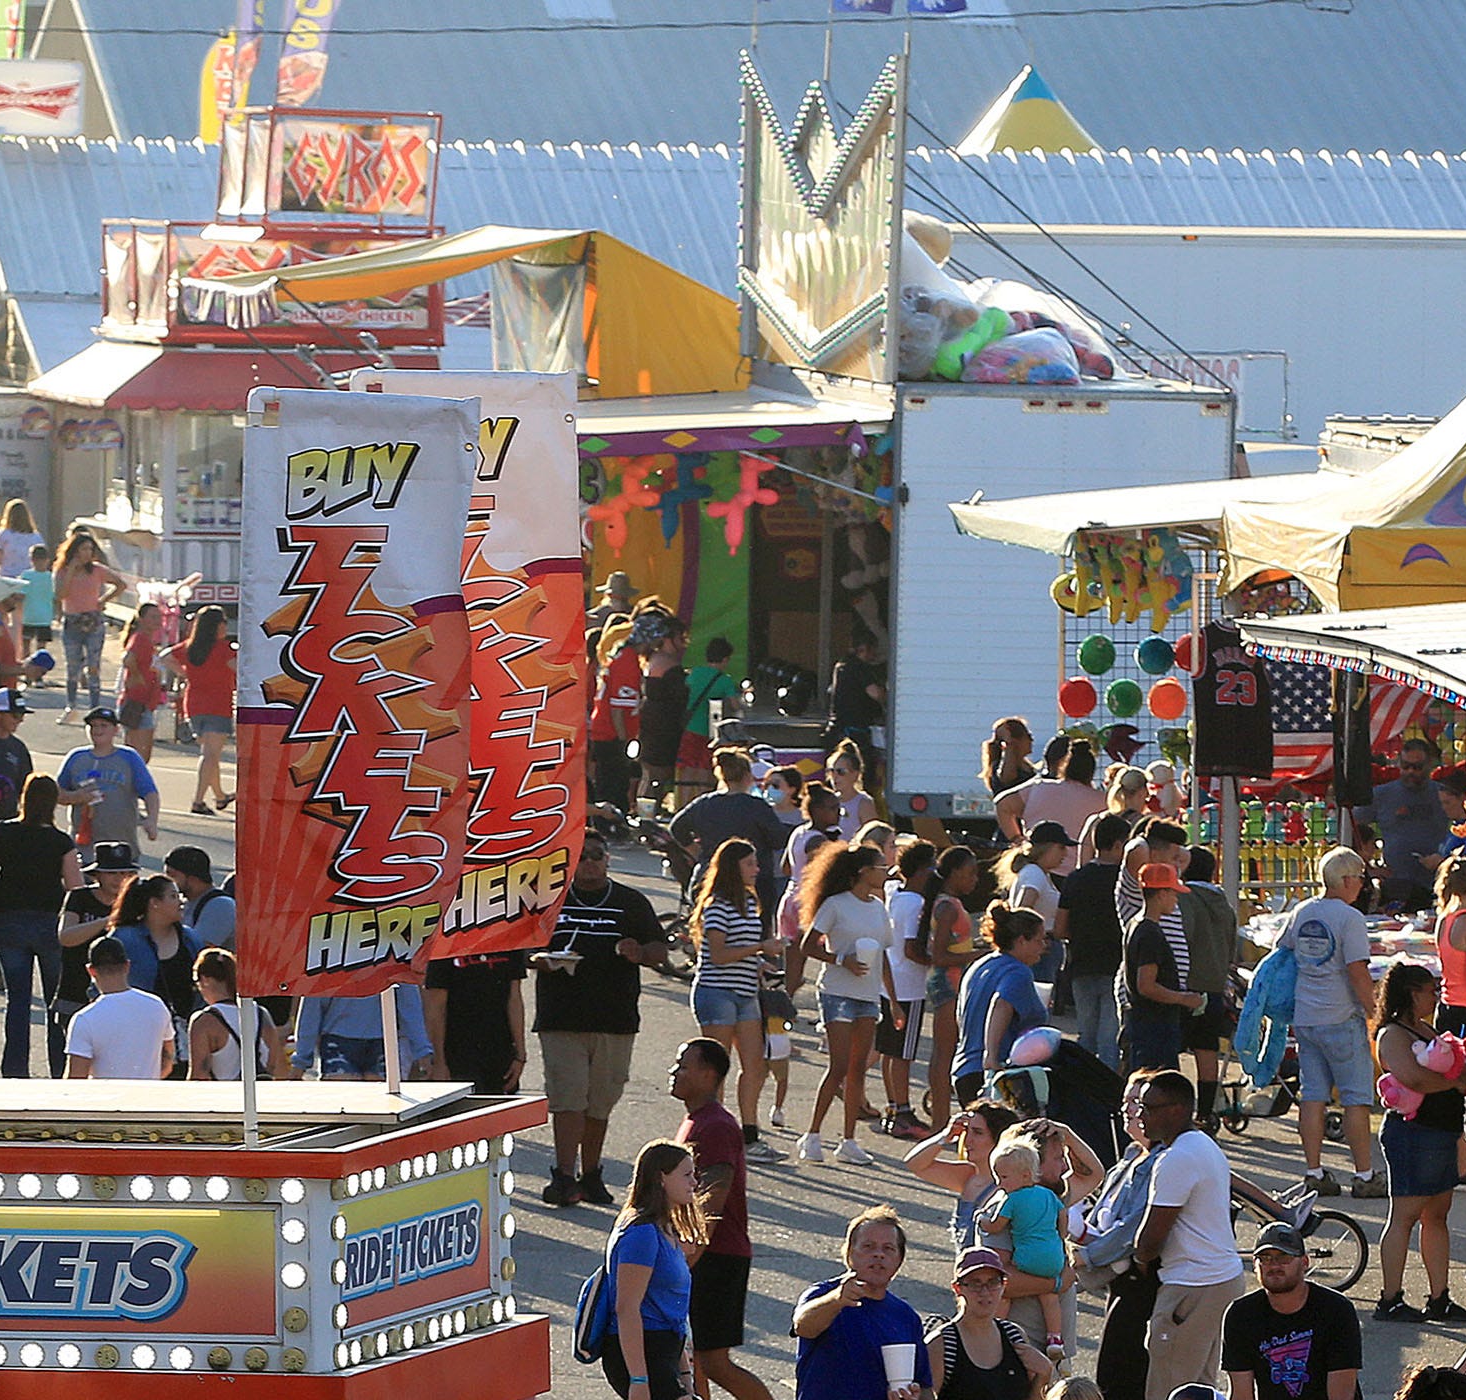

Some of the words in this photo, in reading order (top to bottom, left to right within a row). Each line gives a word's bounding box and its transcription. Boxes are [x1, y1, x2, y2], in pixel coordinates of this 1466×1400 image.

[285, 131, 425, 208] GYROS
[357, 310, 415, 324] CHICKEN
[286, 444, 420, 521] BUY
[277, 525, 448, 906] TICKETS
[1215, 670, 1257, 706] 23
[443, 849, 569, 935] HERE
[345, 1224, 394, 1292] RIDE
[396, 1203, 482, 1277] TICKETS
